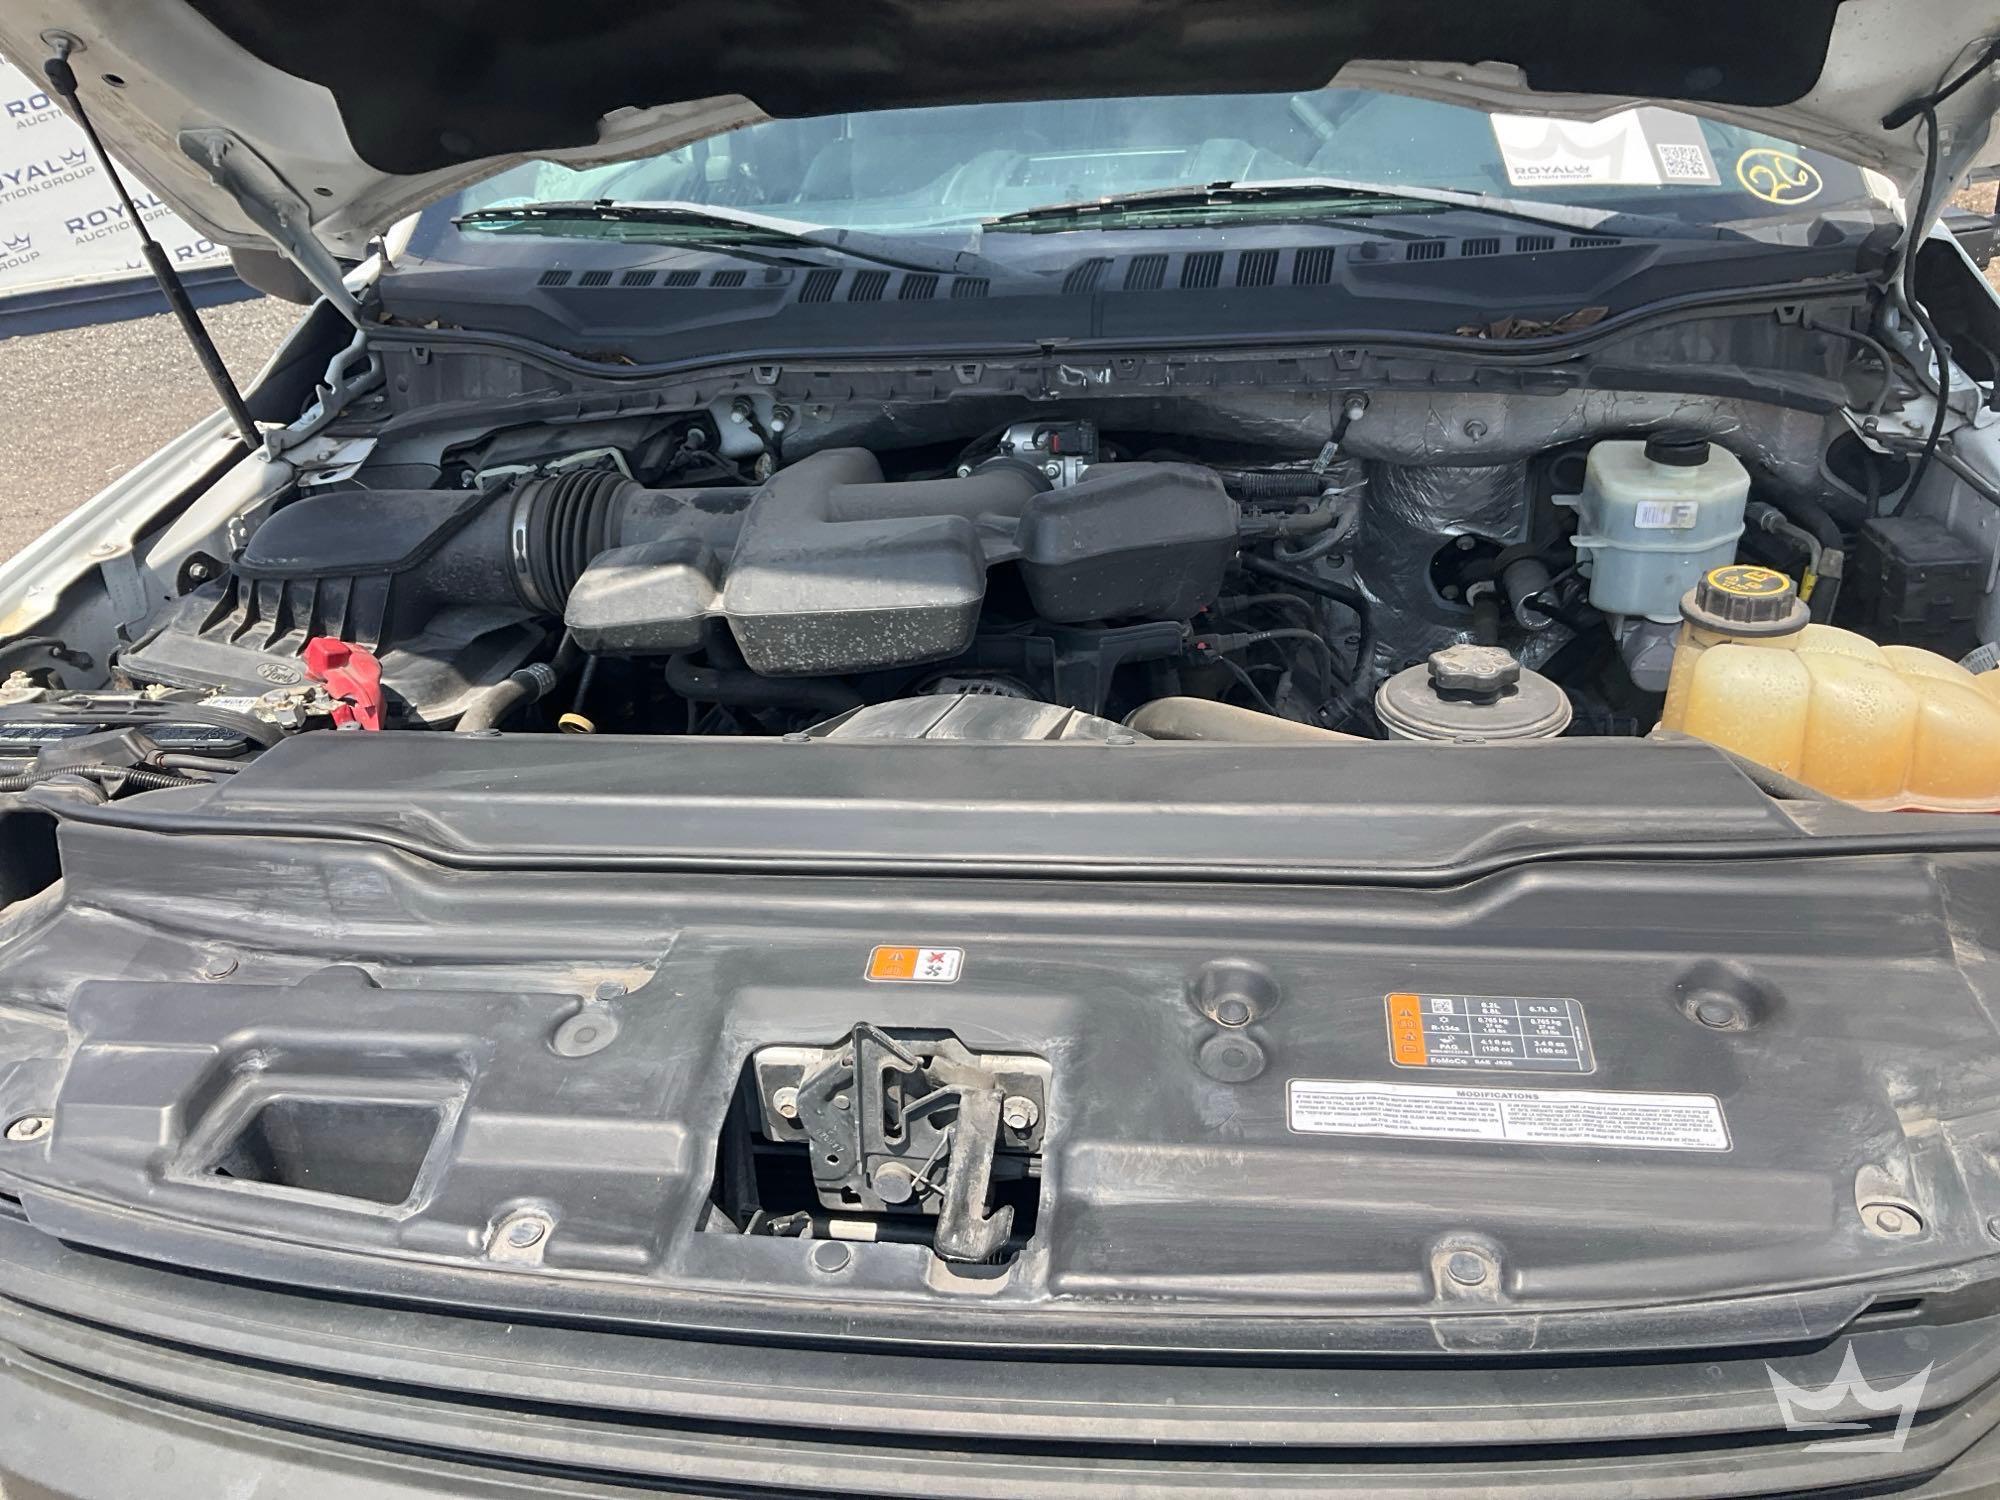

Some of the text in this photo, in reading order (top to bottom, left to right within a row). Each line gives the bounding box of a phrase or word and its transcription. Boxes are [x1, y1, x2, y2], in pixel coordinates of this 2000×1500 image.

[16, 109, 63, 130] AUCTI
[0, 160, 64, 190] YAL
[1514, 166, 1575, 175] ROYAL
[0, 166, 96, 204] TION GROUP
[64, 193, 162, 234] ROYAL
[0, 251, 40, 271] ROUP
[262, 663, 297, 683] Ford
[1430, 1057, 1468, 1065] FoMoCo
[1456, 1090, 1540, 1100] MODIFICATIONS
